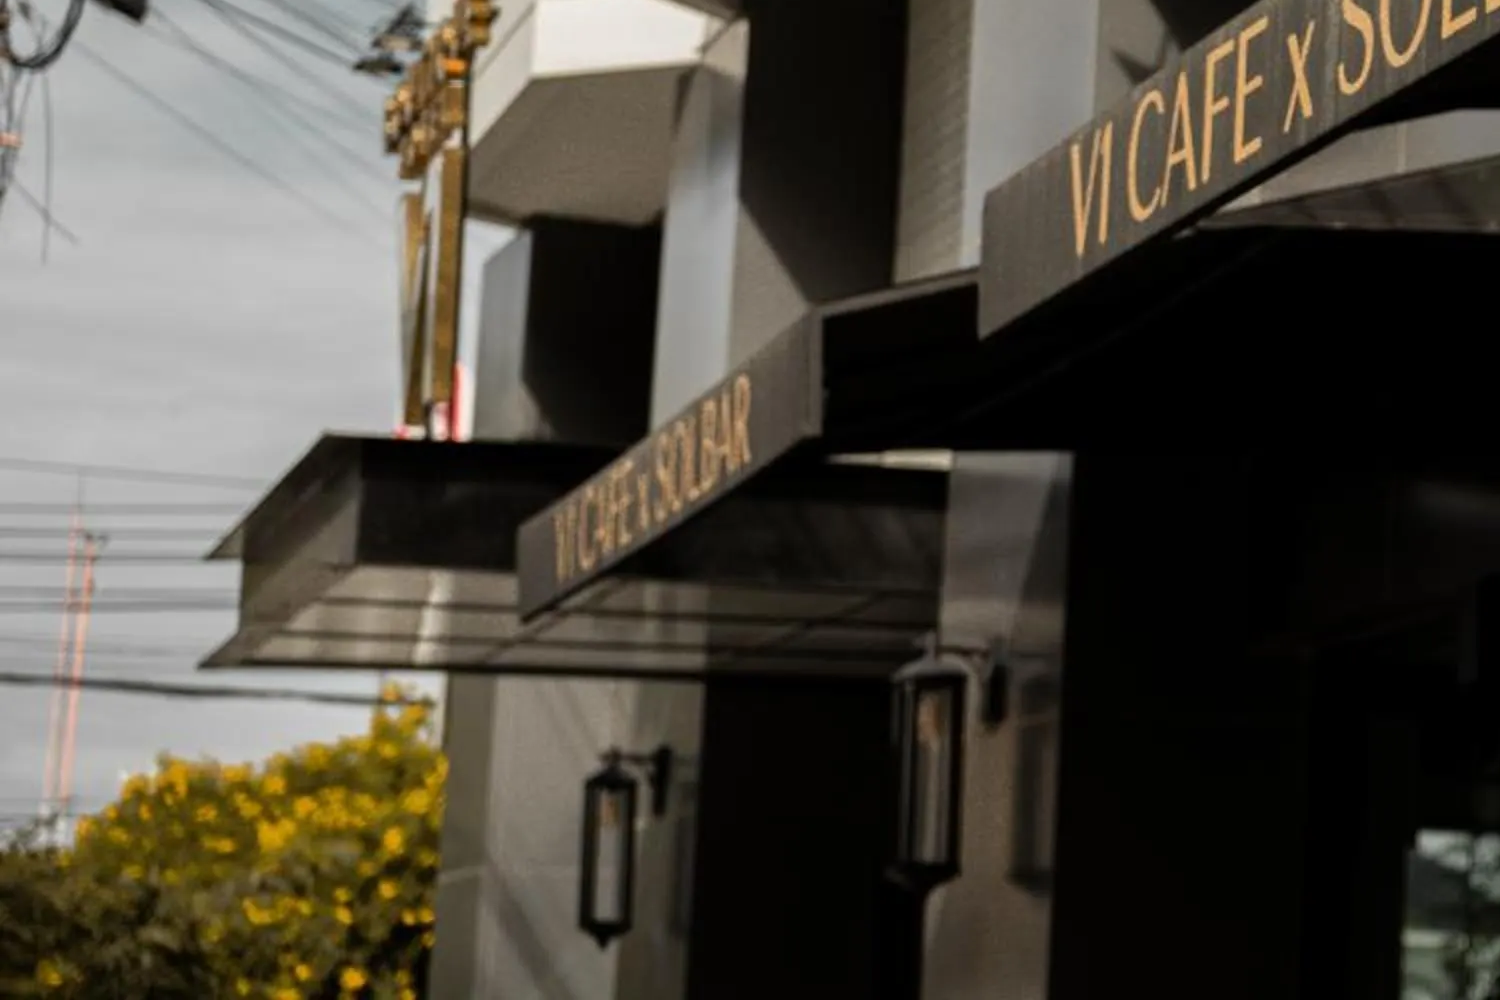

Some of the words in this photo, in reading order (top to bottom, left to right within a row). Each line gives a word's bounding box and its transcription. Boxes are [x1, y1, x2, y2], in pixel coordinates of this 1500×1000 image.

[1069, 119, 1113, 259] VI
[1125, 15, 1269, 223] CAFE
[578, 459, 635, 570] CAFE
